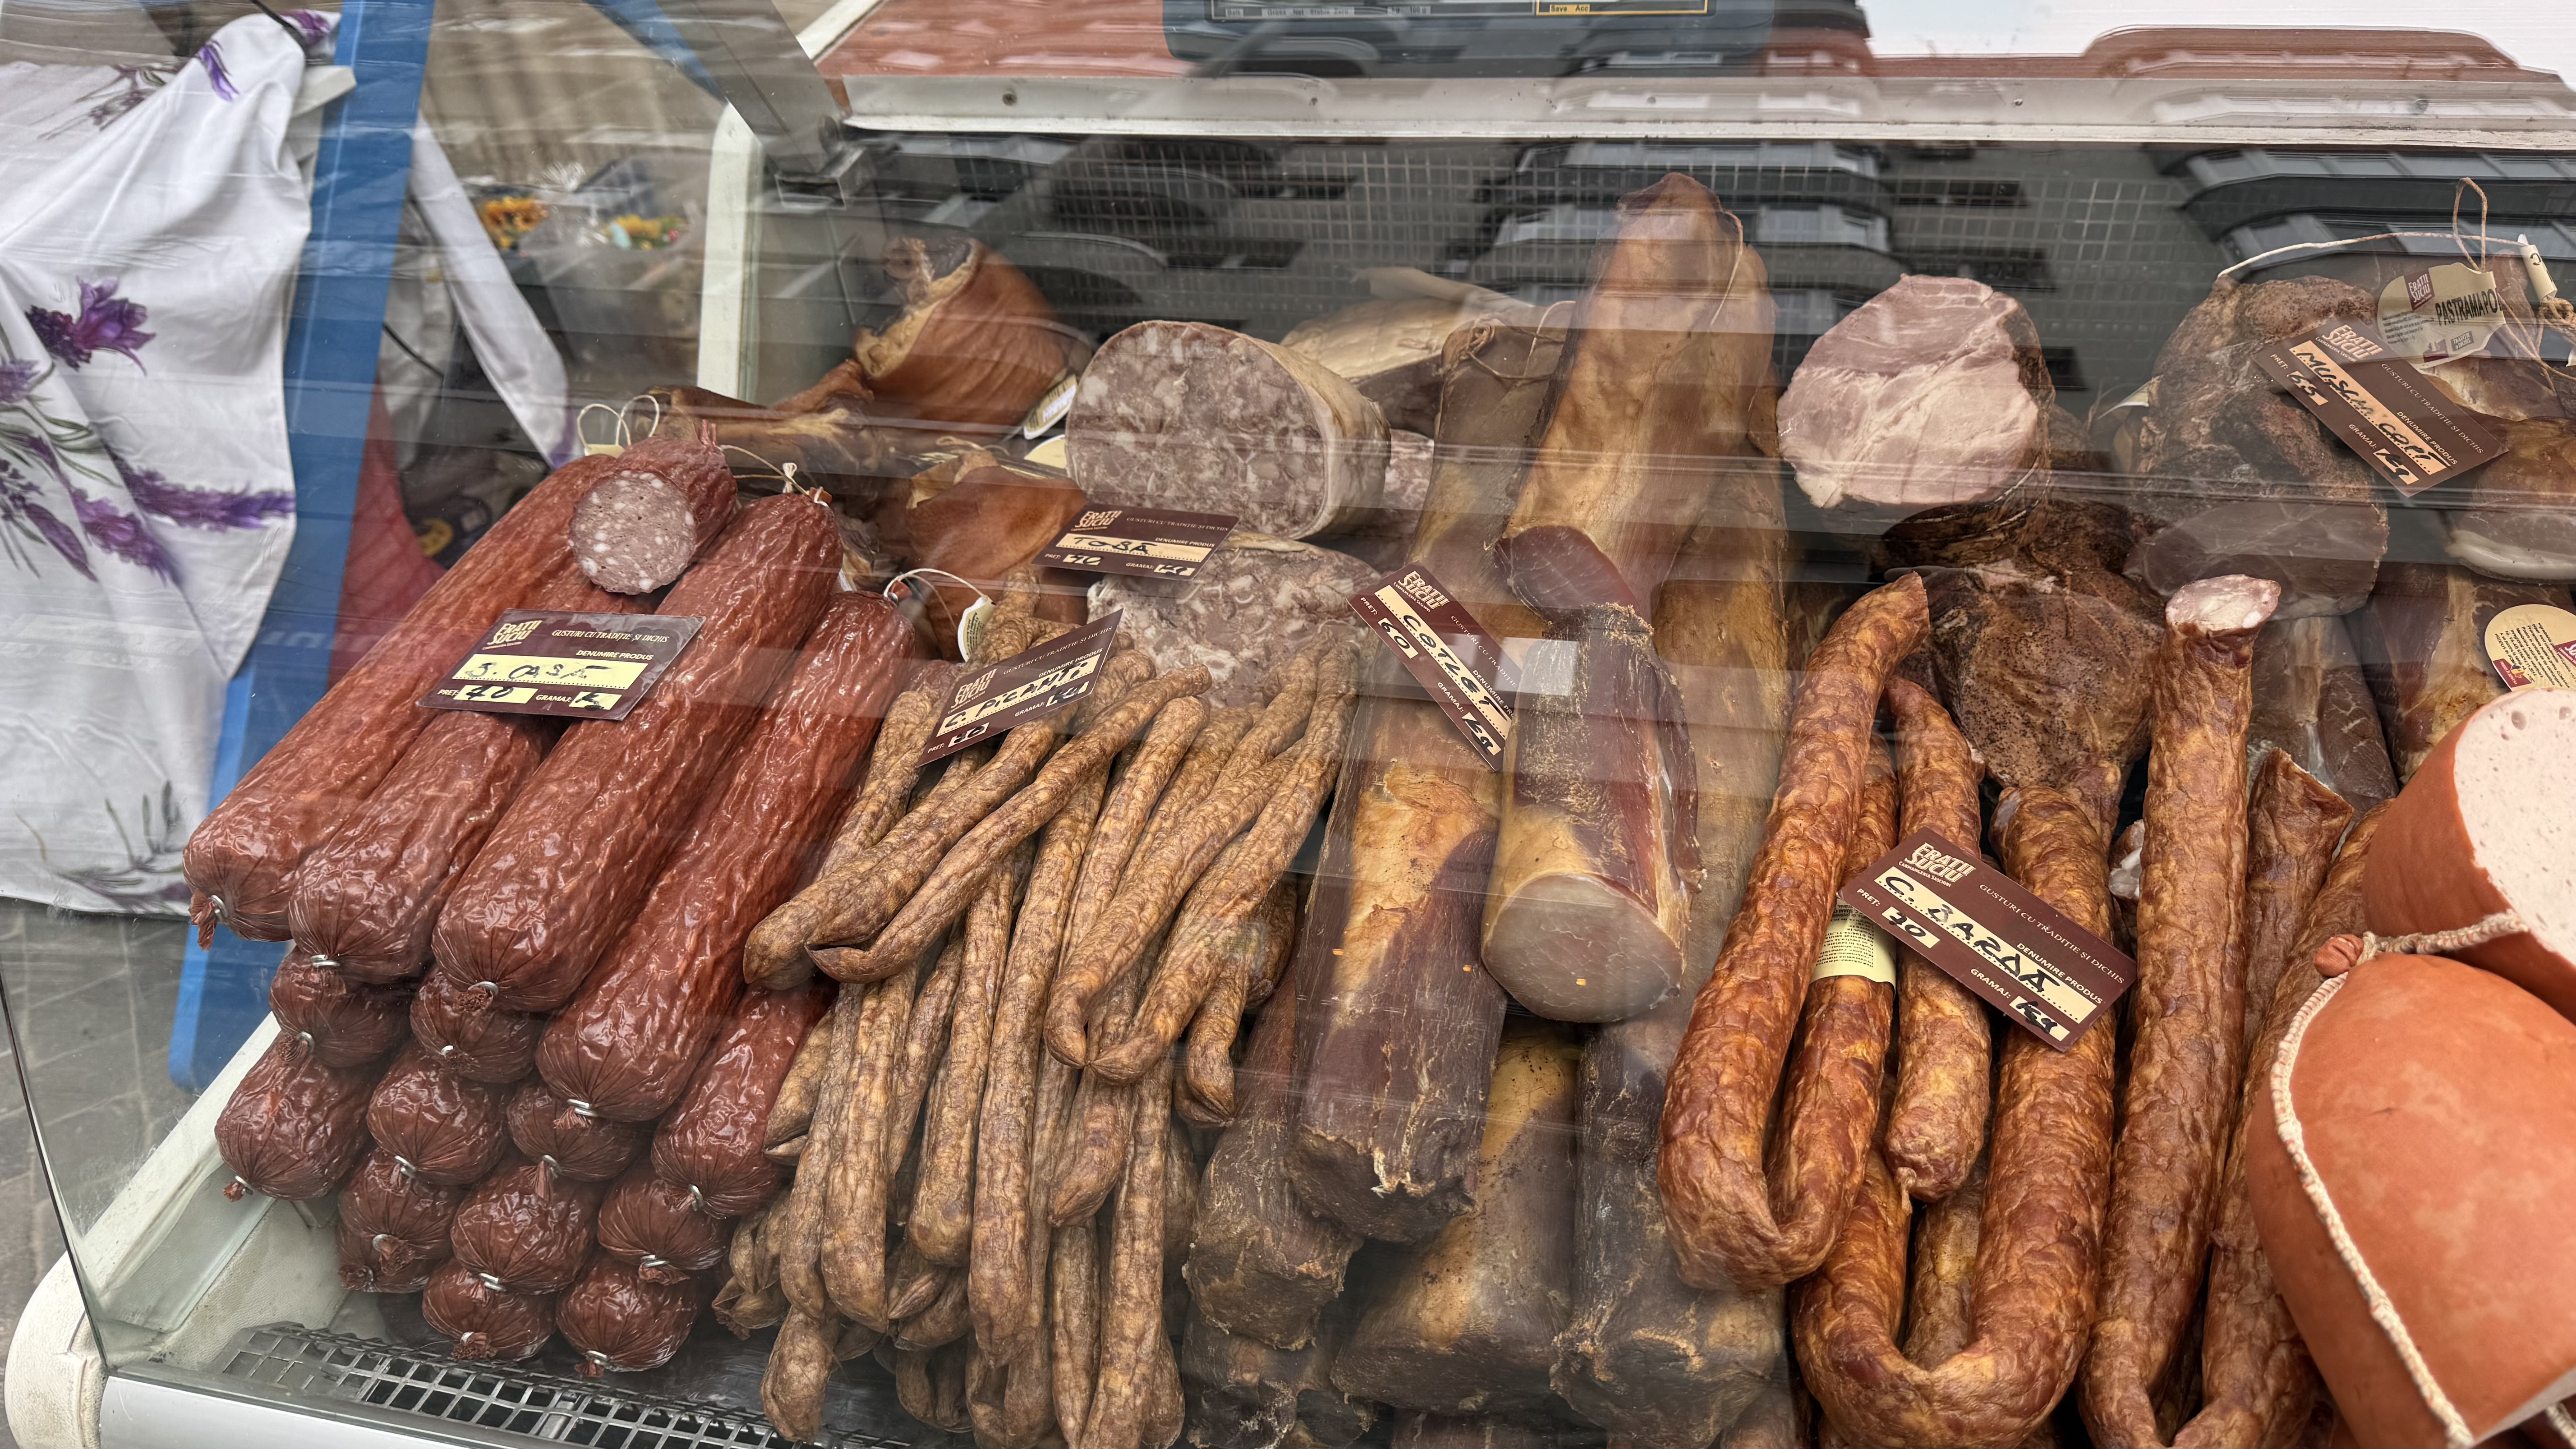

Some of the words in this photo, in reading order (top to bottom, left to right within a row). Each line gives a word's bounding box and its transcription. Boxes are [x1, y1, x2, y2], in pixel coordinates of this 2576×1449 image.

[2382, 363, 2411, 389] GUSTURI
[2410, 389, 2421, 398] CU
[2459, 432, 2484, 454] DICHIS
[2349, 423, 2377, 450] GRAMAJ:
[2397, 411, 2432, 442] DENUMIRE
[2430, 440, 2458, 465] PRODUS
[642, 634, 670, 642] DICHIS
[1003, 659, 1034, 675] GUSTURI
[1033, 653, 1045, 662] CU
[1087, 626, 1113, 640] DICHIS
[1381, 622, 1410, 649] 60
[1451, 616, 1479, 645] GUSTURI
[1478, 645, 1489, 655] CU
[576, 650, 620, 658] DENUMIRE
[1038, 660, 1074, 678] DENUMIRE
[1075, 648, 1103, 662] PRODUS
[535, 694, 572, 702] GRAMAJ:
[1437, 681, 1465, 713] GRAMAJ:
[1472, 669, 1505, 705] DENUMIRE
[1015, 702, 1045, 717] GRAMAJ:
[1898, 861, 1931, 879] CARMANGERIA
[1904, 851, 1964, 883] SUCIU
[1885, 876, 1914, 902] C.
[1979, 884, 2022, 914] GUSTURI
[2020, 912, 2036, 923] CU
[2090, 958, 2125, 984] DICHIS
[1970, 968, 2012, 999] GRAMAJ:
[2016, 943, 2065, 978] DENUMIRE
[2065, 975, 2104, 1004] PRODUS
